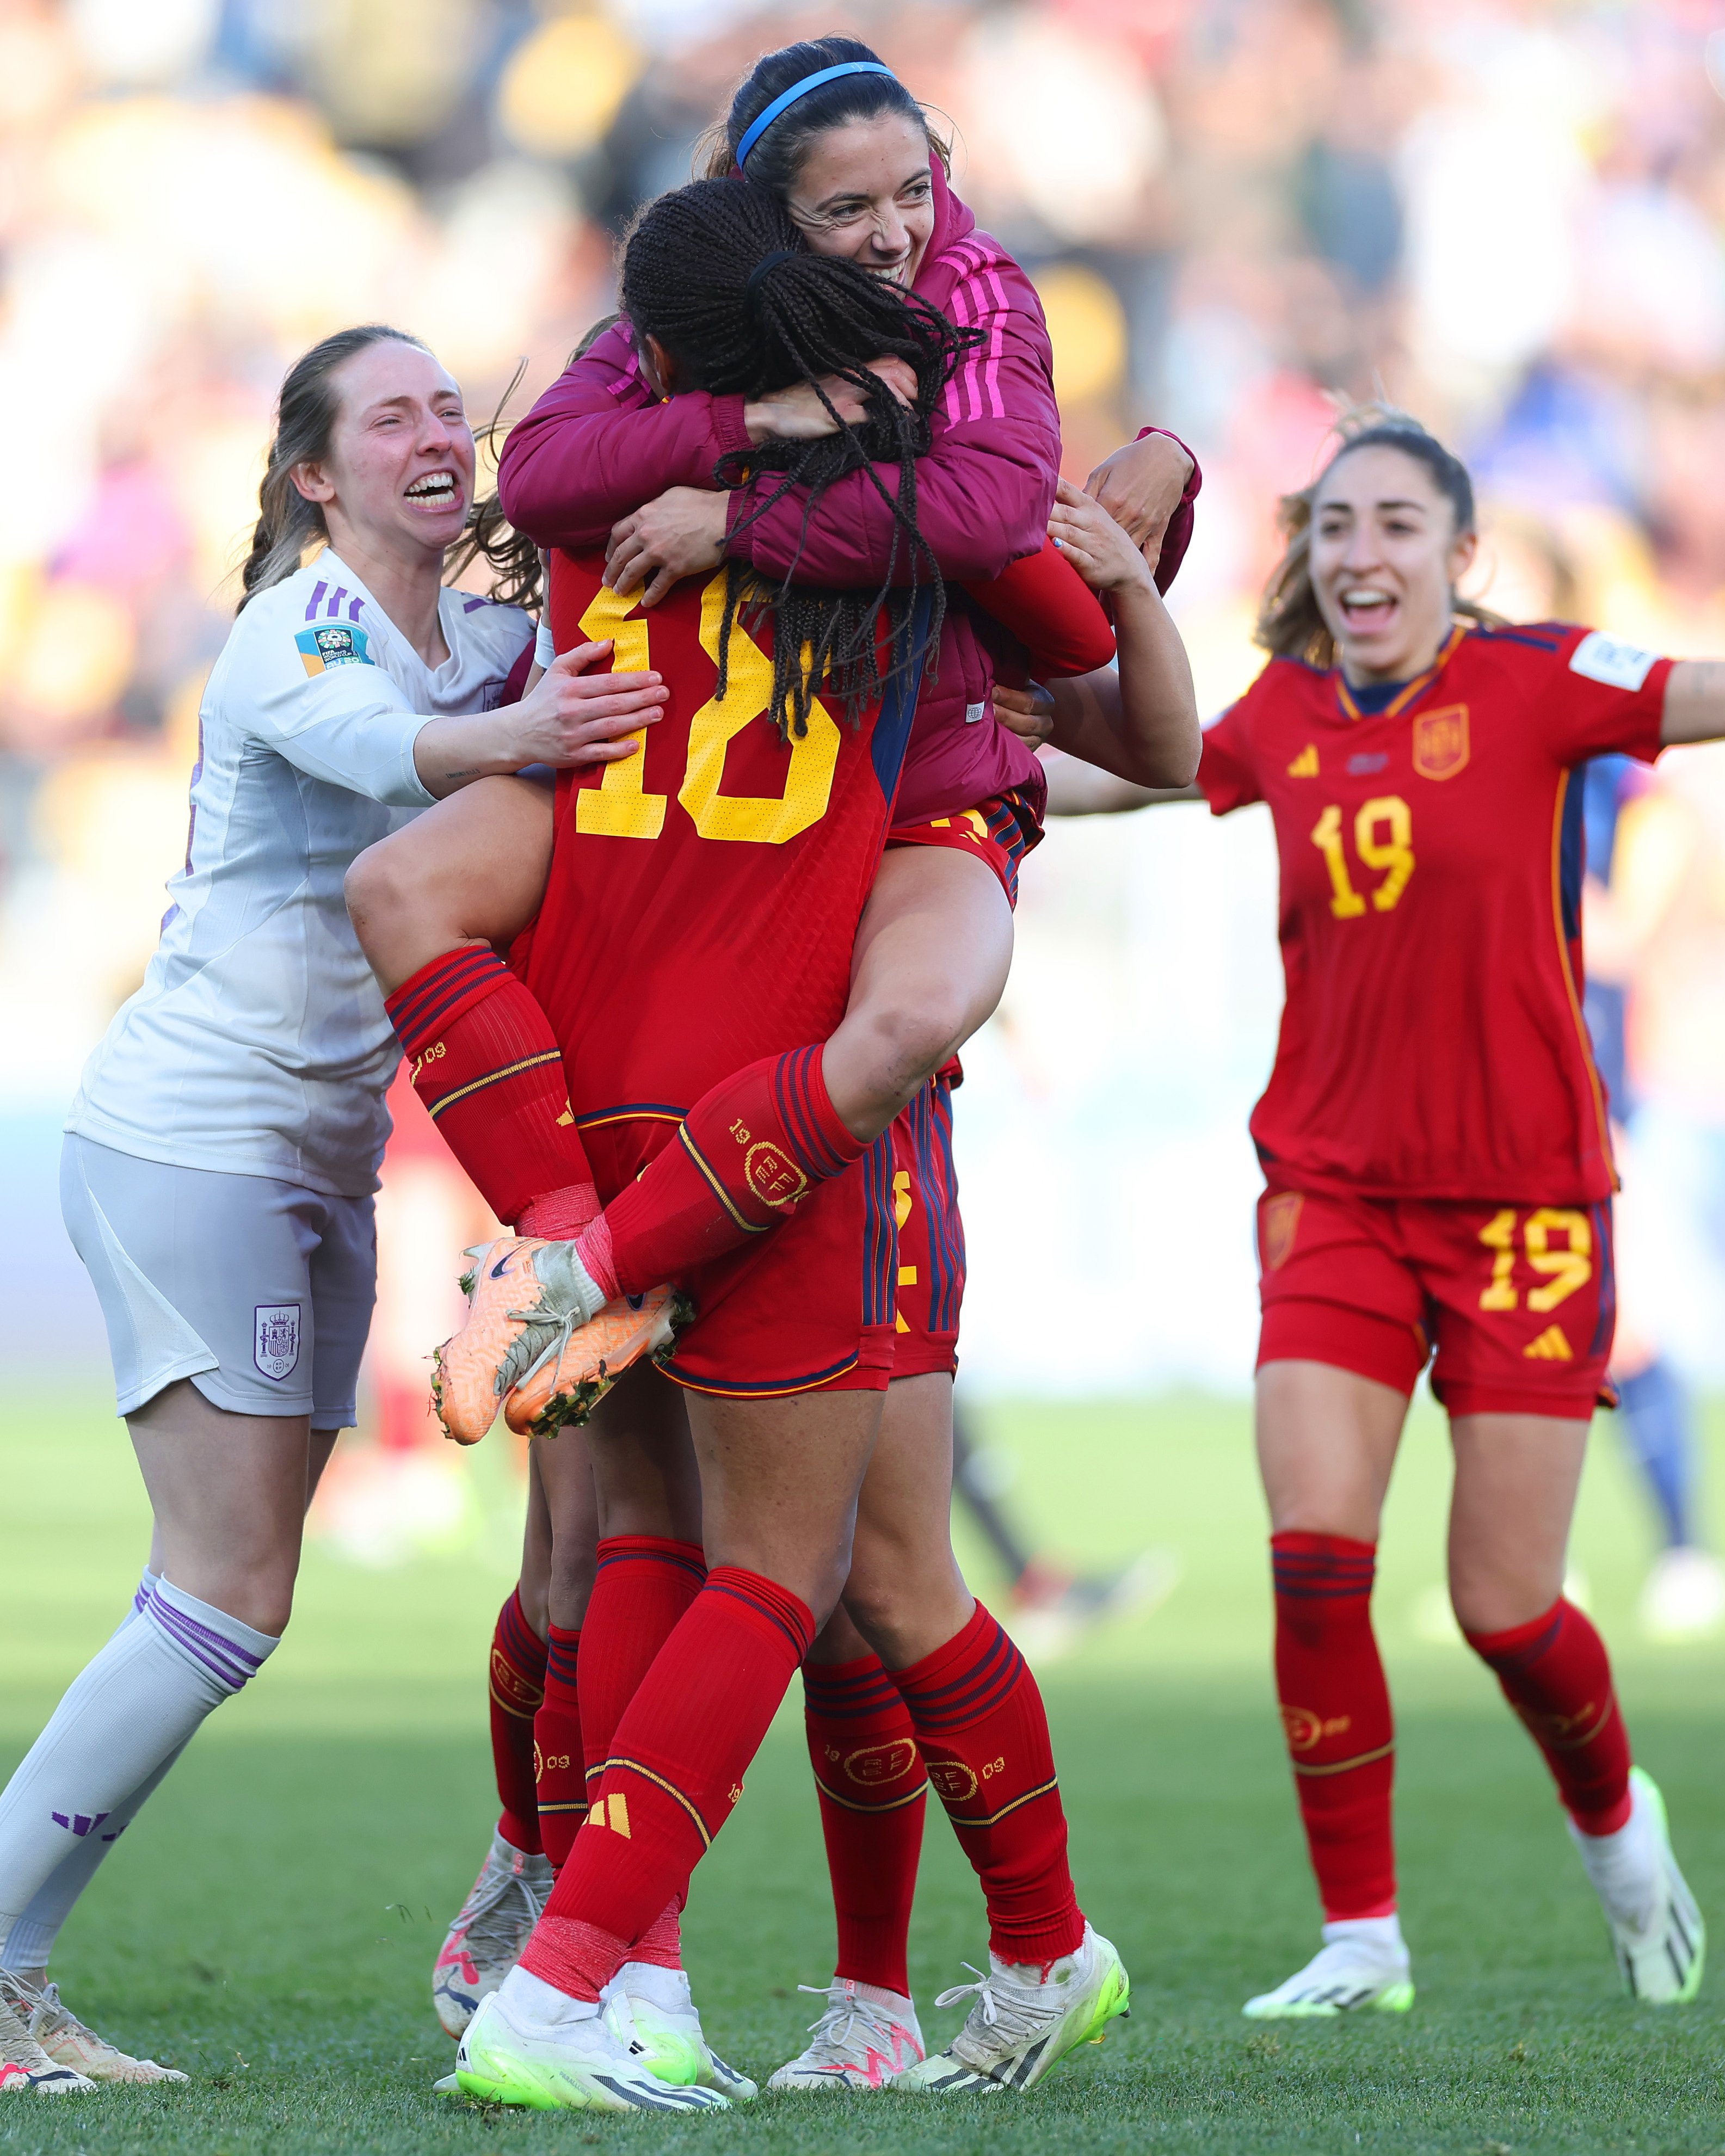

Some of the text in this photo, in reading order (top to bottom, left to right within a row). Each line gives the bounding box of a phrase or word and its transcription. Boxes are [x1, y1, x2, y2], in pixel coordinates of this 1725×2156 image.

[324, 654, 342, 662] WORLD
[576, 564, 840, 845] 18
[1311, 795, 1414, 920] 19
[424, 1042, 447, 1063] 09
[729, 1118, 751, 1144] 19
[1479, 1208, 1592, 1313] 19
[546, 1754, 570, 1769] 09
[982, 1757, 1005, 1779] 09
